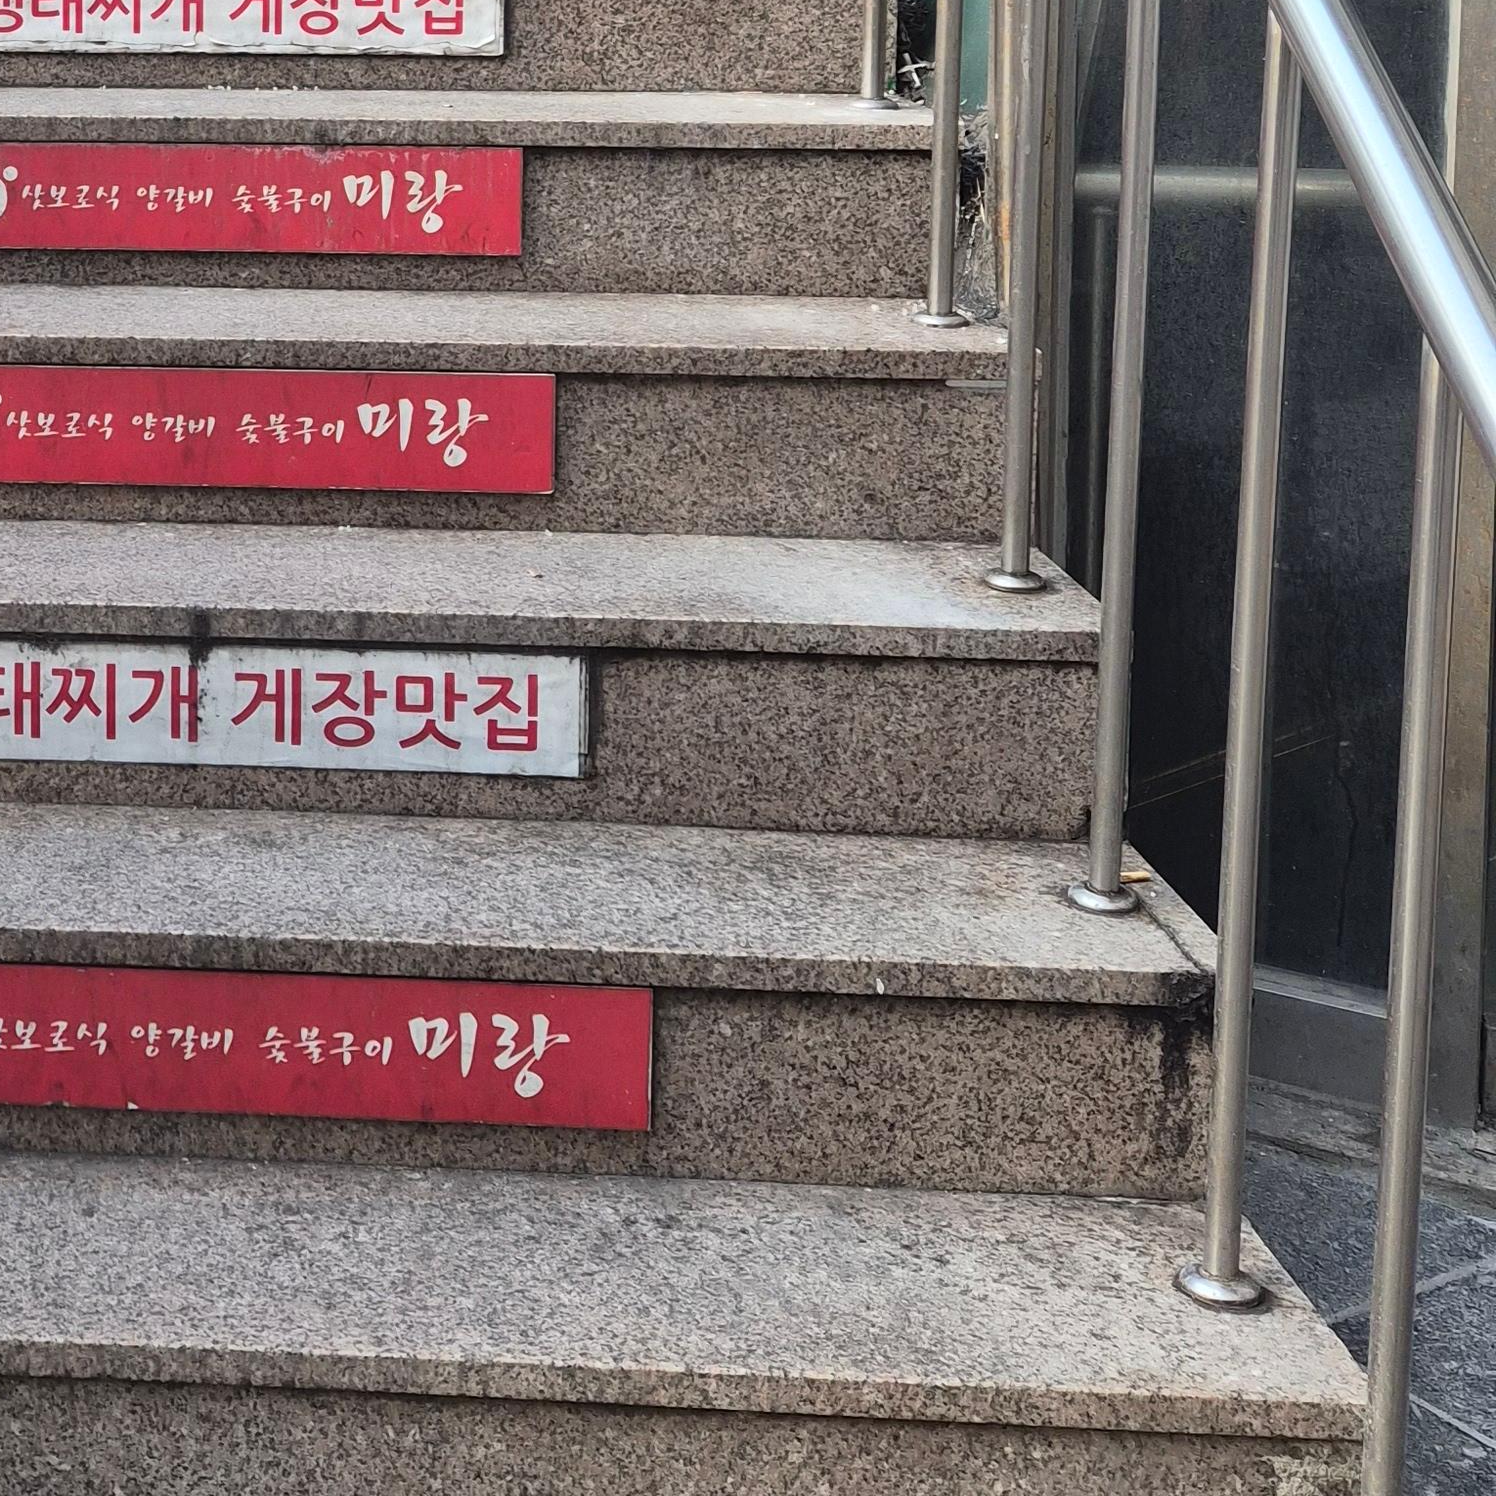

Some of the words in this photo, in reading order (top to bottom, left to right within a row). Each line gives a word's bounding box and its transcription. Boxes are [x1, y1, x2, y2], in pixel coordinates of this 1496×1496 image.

[136, 187, 212, 211] 양갈비
[231, 187, 332, 214] 숯불구이
[343, 169, 463, 234] 미랑
[131, 412, 216, 441] 양갈비
[235, 415, 344, 445] 숯불구이
[356, 397, 488, 468] 미랑
[231, 667, 540, 752] 게장맛집
[130, 1023, 234, 1059] 양갈비
[257, 1023, 394, 1067] 숯불구이
[409, 1010, 570, 1098] 미랑
